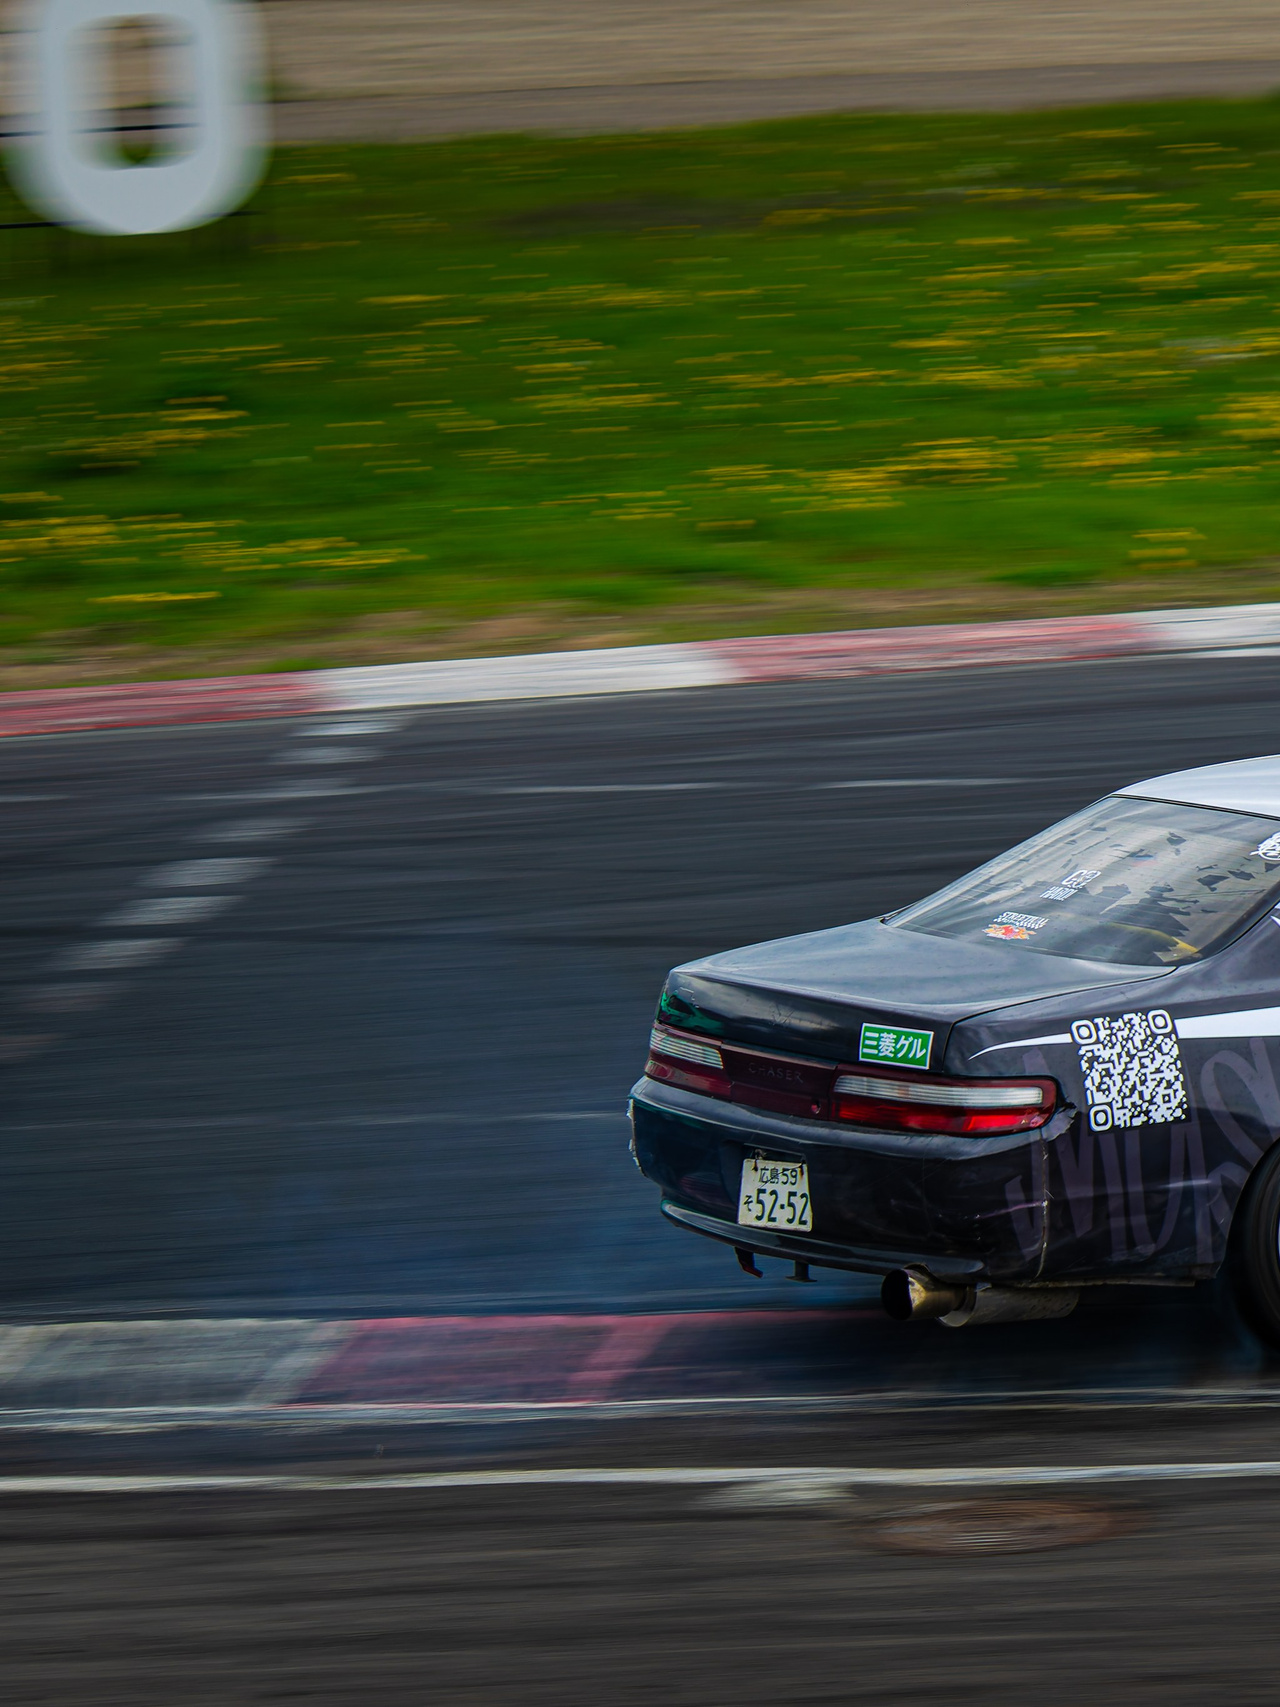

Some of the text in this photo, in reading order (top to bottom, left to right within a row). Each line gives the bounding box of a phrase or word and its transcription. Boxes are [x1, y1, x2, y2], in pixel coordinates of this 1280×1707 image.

[863, 1031, 927, 1060] 三菱グル
[749, 1062, 804, 1083] CHASER
[755, 1188, 809, 1225] 52-52
